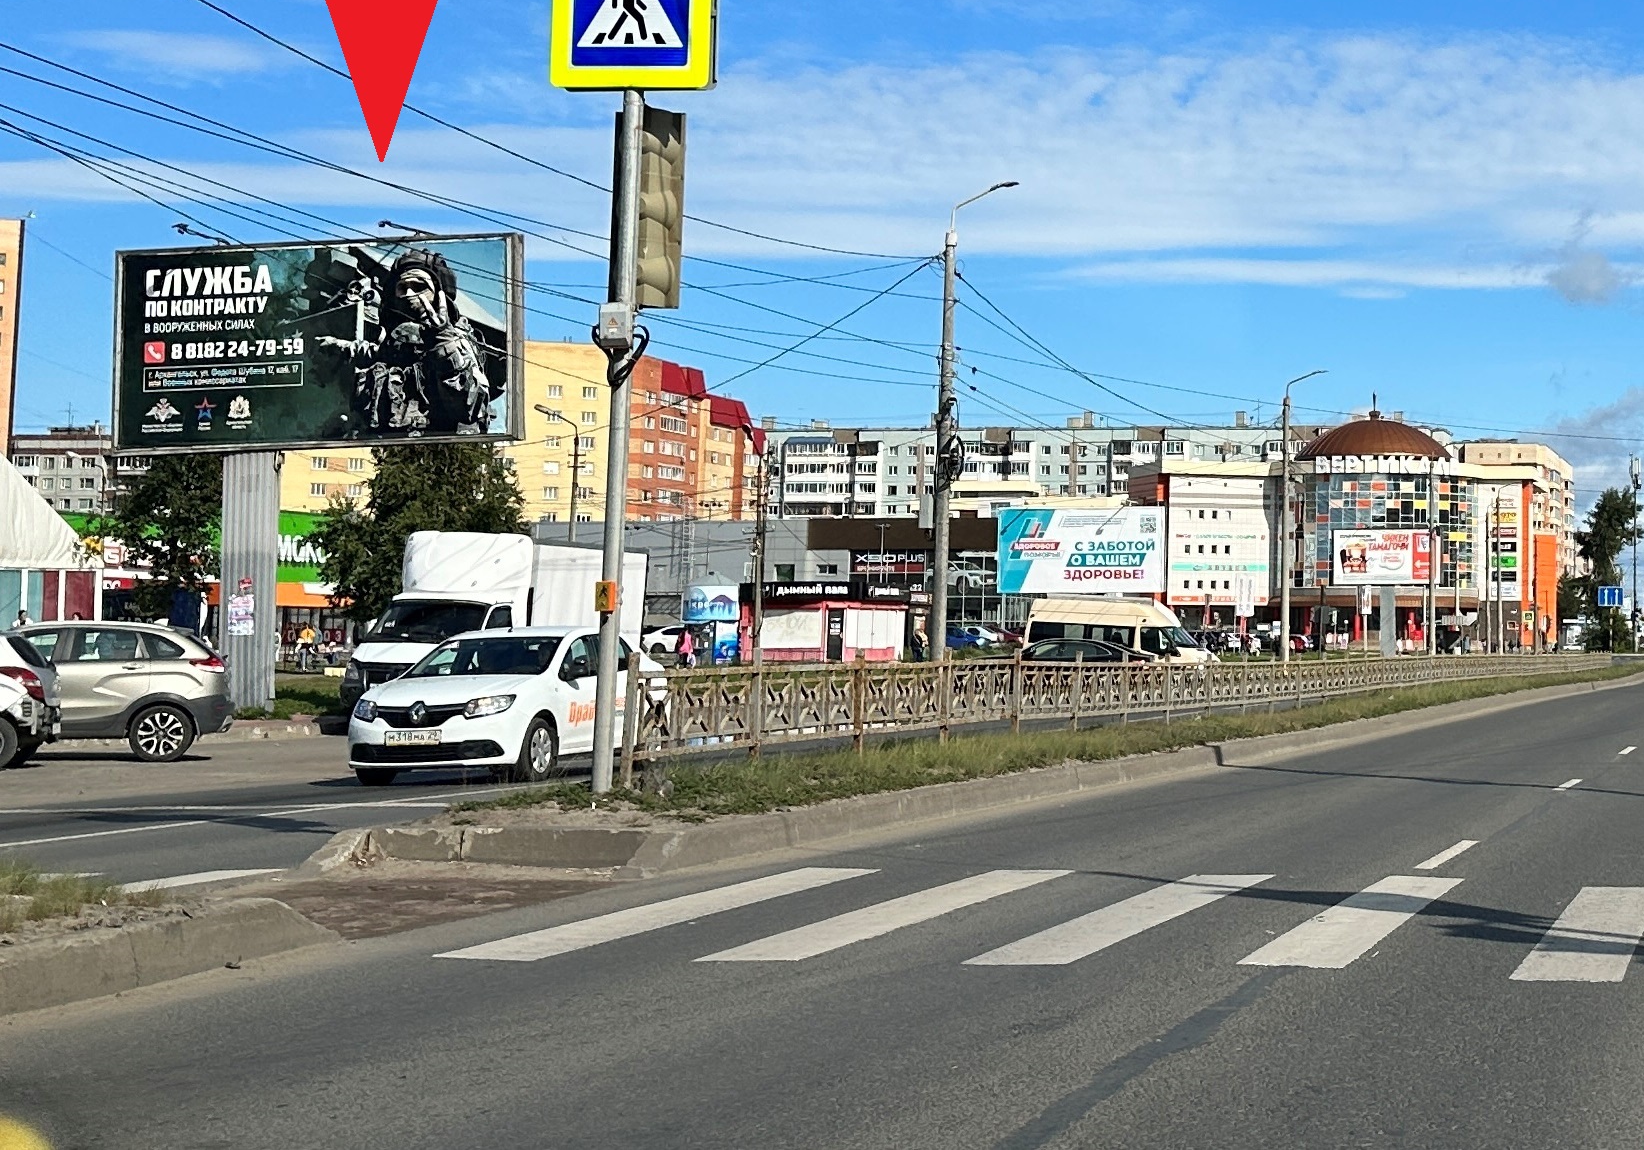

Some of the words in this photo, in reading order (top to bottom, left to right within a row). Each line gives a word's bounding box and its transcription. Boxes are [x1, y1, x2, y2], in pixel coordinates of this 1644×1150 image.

[145, 264, 273, 297] СЛУЖБА
[144, 300, 168, 317] ПО
[170, 296, 268, 317] КОНТРАКТУ
[144, 323, 151, 333] В
[153, 320, 223, 333] ВООРУЖЕННЫХ
[225, 318, 255, 331] СИЛАХ
[171, 343, 182, 360] 8
[185, 341, 225, 359] 8182
[227, 338, 304, 358] 24-79-59
[1075, 541, 1083, 551] С
[1087, 538, 1155, 551] ЗАБОТОЙ
[1070, 554, 1080, 565] О
[1085, 554, 1140, 565] ВАШЕМ
[1064, 569, 1145, 581] ЗДОРОВЬЕ!
